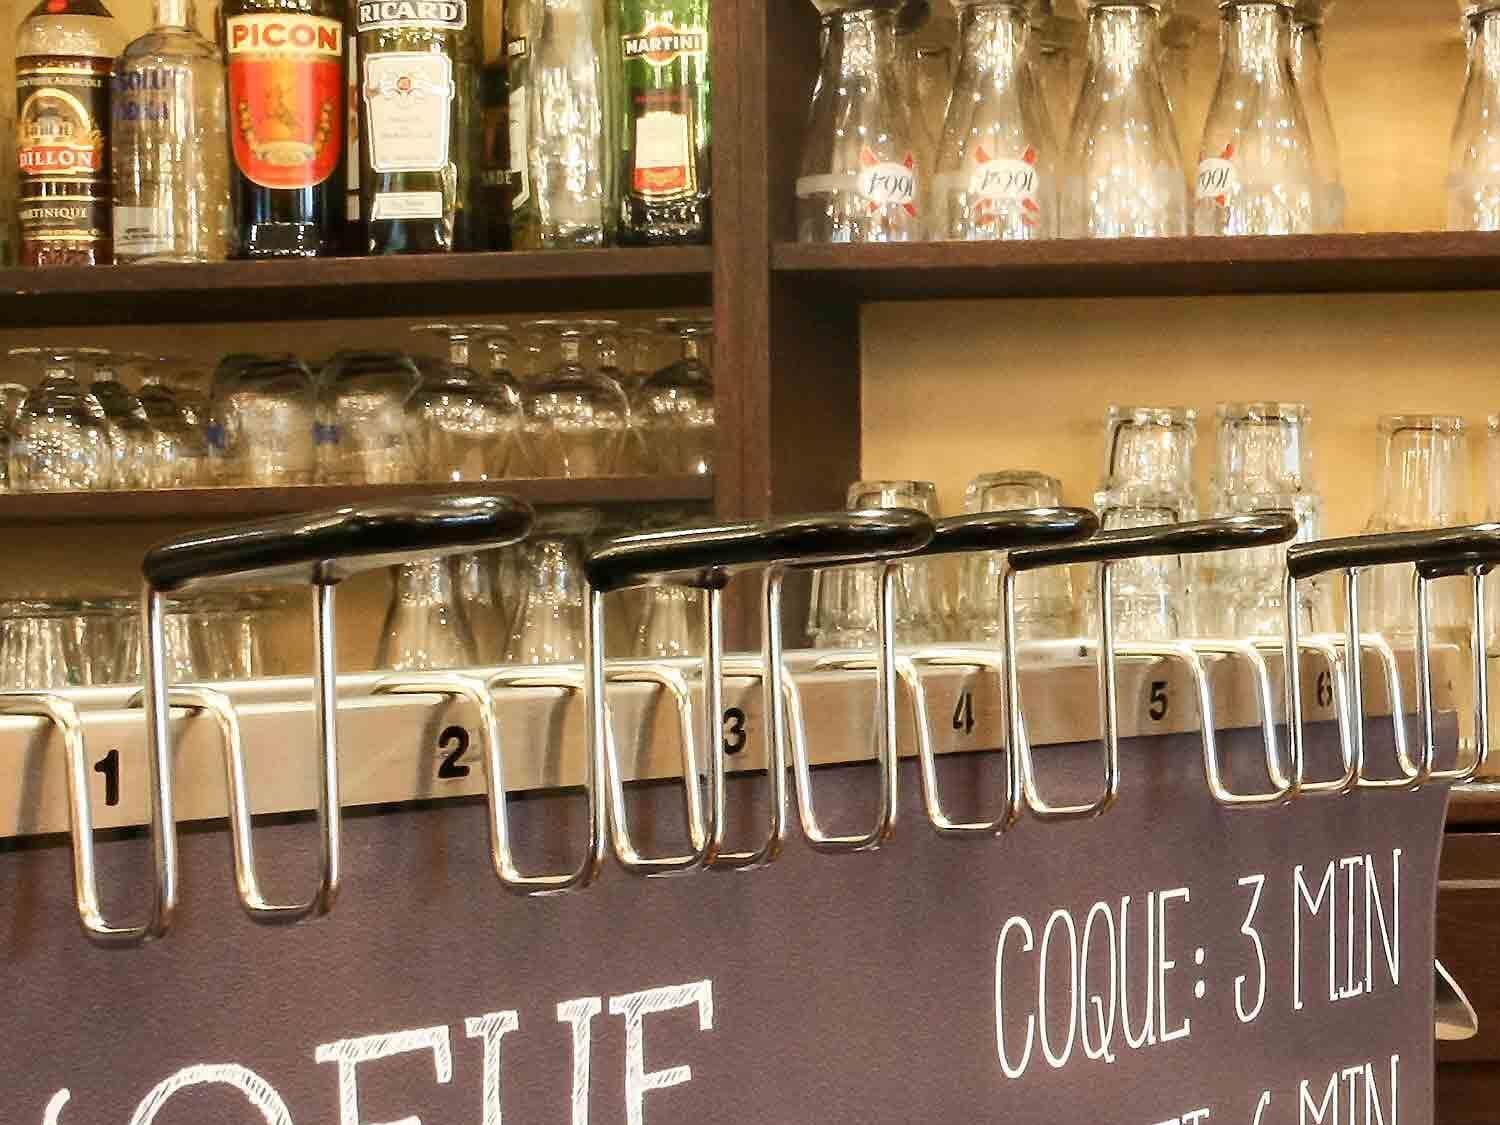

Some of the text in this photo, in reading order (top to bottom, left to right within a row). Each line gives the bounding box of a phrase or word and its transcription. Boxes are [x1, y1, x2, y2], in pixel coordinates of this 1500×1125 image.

[360, 1, 459, 23] RICARD
[232, 24, 338, 50] PICON
[625, 33, 704, 55] MARTINI
[19, 148, 93, 169] DILLON
[95, 671, 1333, 806] 1 2 3 4 5 6
[995, 848, 1402, 1078] COQUE: 3 MIN
